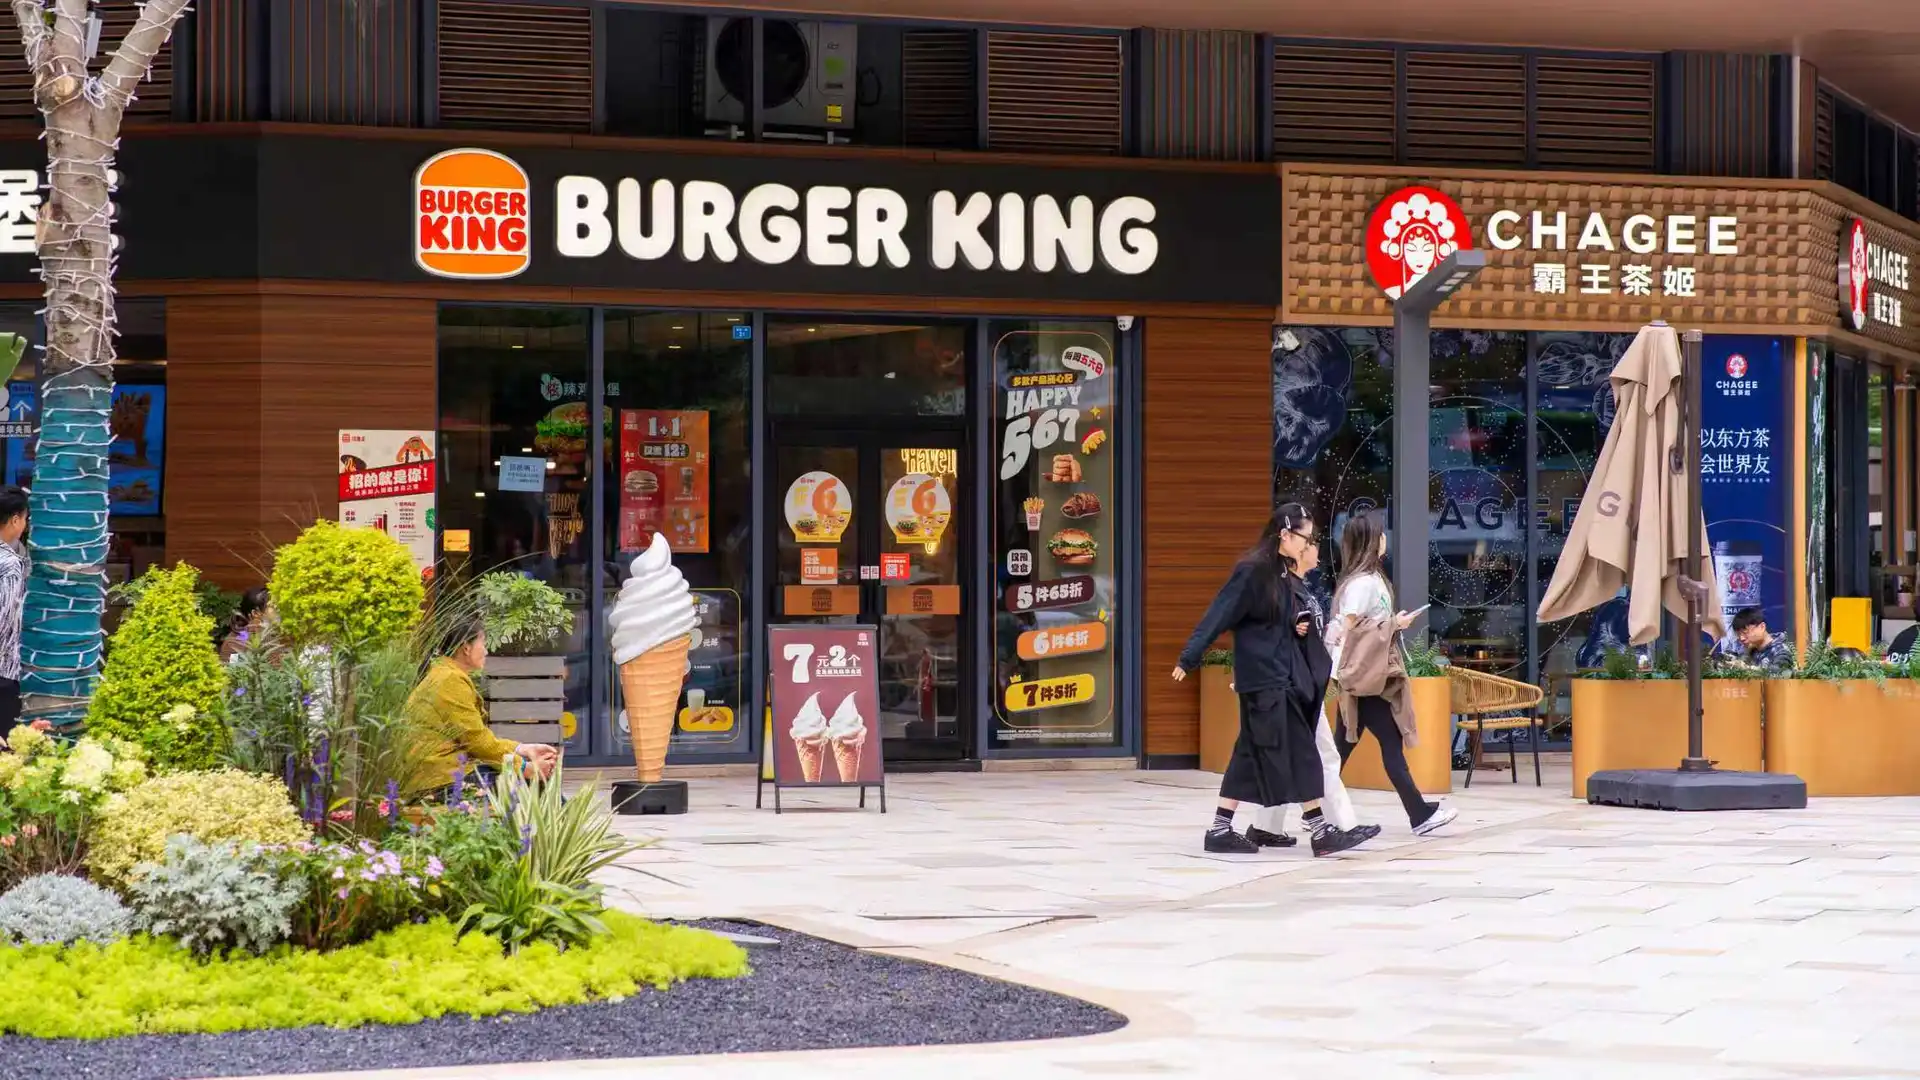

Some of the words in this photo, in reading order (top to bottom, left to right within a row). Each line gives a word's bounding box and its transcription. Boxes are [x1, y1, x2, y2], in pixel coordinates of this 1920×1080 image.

[420, 189, 527, 216] BURGER
[420, 215, 527, 251] KING
[556, 175, 911, 269] BURGER
[932, 190, 1158, 274] KING
[1487, 210, 1738, 254] CHAGEE
[1533, 262, 1697, 297] 霸王茶姬
[1866, 242, 1908, 290] CHAGEE
[1715, 381, 1758, 389] CHAGEE
[1006, 386, 1082, 420] HAPPY
[648, 416, 680, 436] 1+1
[1700, 428, 1771, 448] 以东方茶
[1000, 408, 1080, 480] 567
[1700, 454, 1771, 474] 会世界友
[349, 467, 428, 490] 招的就是你!
[1017, 582, 1084, 610] 5件65折
[1033, 630, 1090, 656] 6件6折
[1023, 683, 1078, 707] 7件5折
